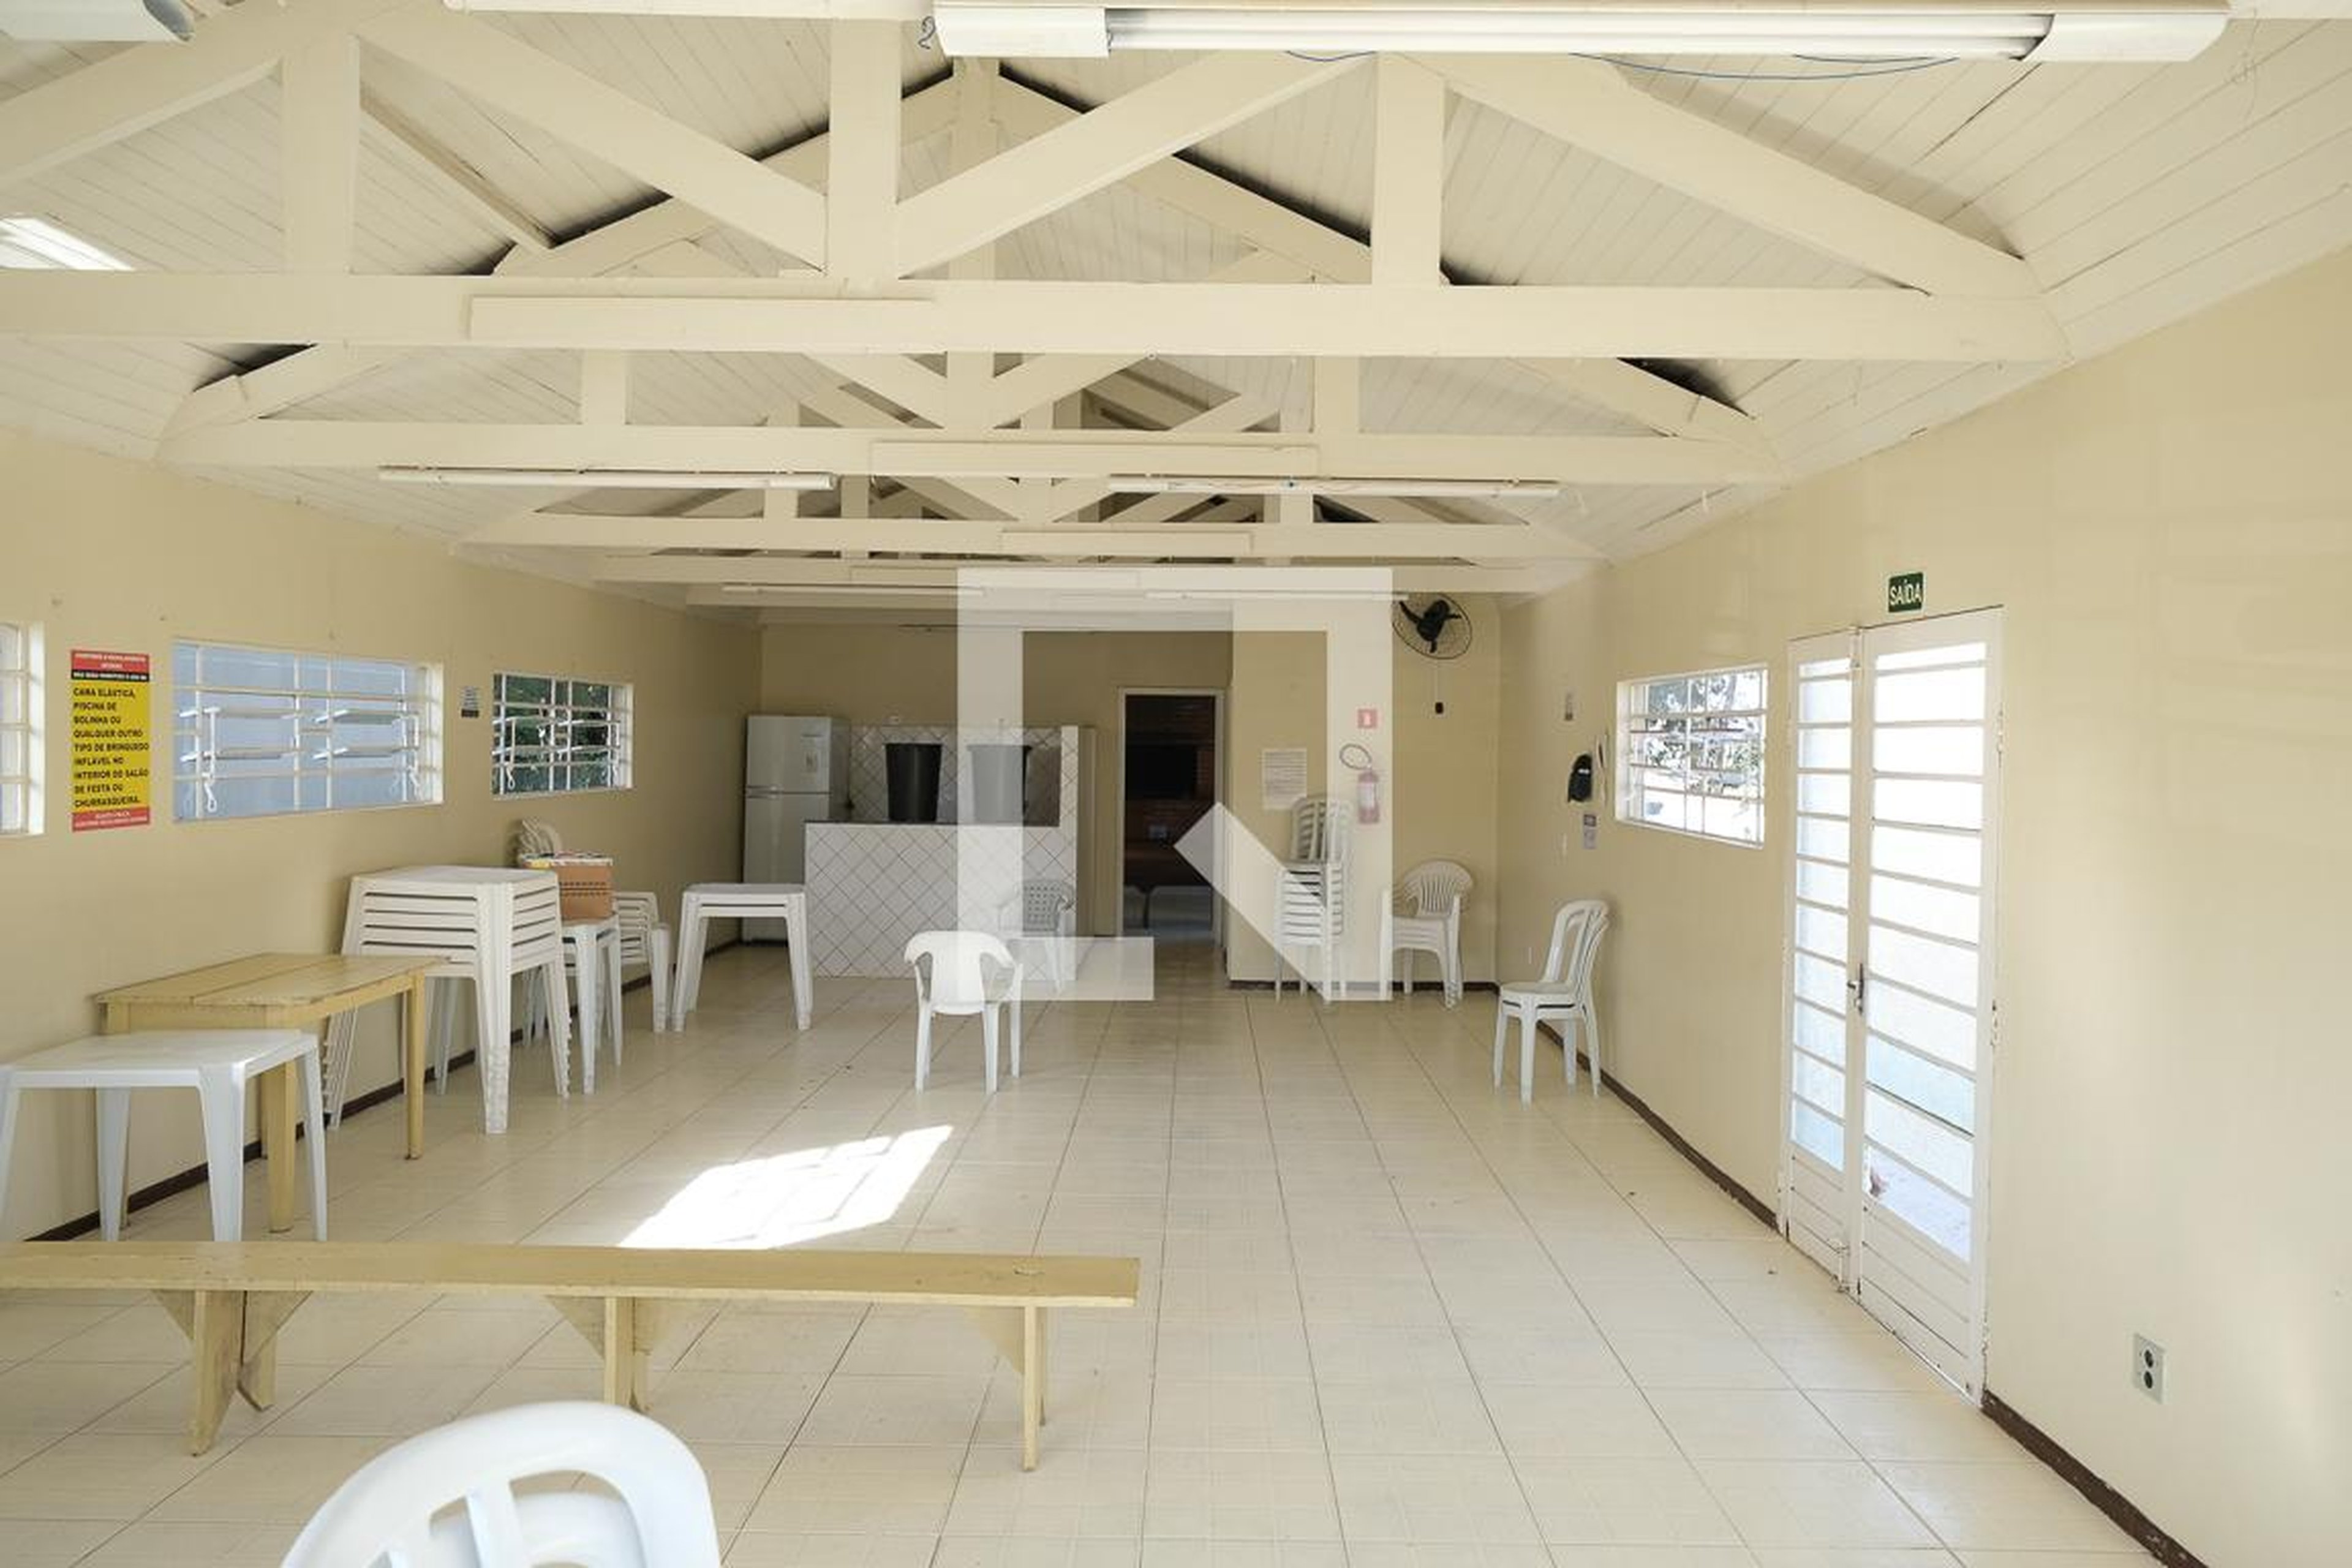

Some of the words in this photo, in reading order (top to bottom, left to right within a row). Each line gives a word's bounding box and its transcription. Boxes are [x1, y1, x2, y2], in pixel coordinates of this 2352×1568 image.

[1890, 578, 1922, 606] SAÍDA
[73, 688, 96, 696] CAMA
[74, 702, 105, 710] PISCINA
[106, 702, 116, 710] DE
[116, 729, 143, 737] OUTRO
[74, 743, 92, 752] TIPO
[94, 743, 104, 752] DE
[74, 770, 110, 778] INTERIOR
[125, 767, 148, 777] SALÃO
[74, 785, 85, 794] DE
[87, 784, 110, 793] FESTA
